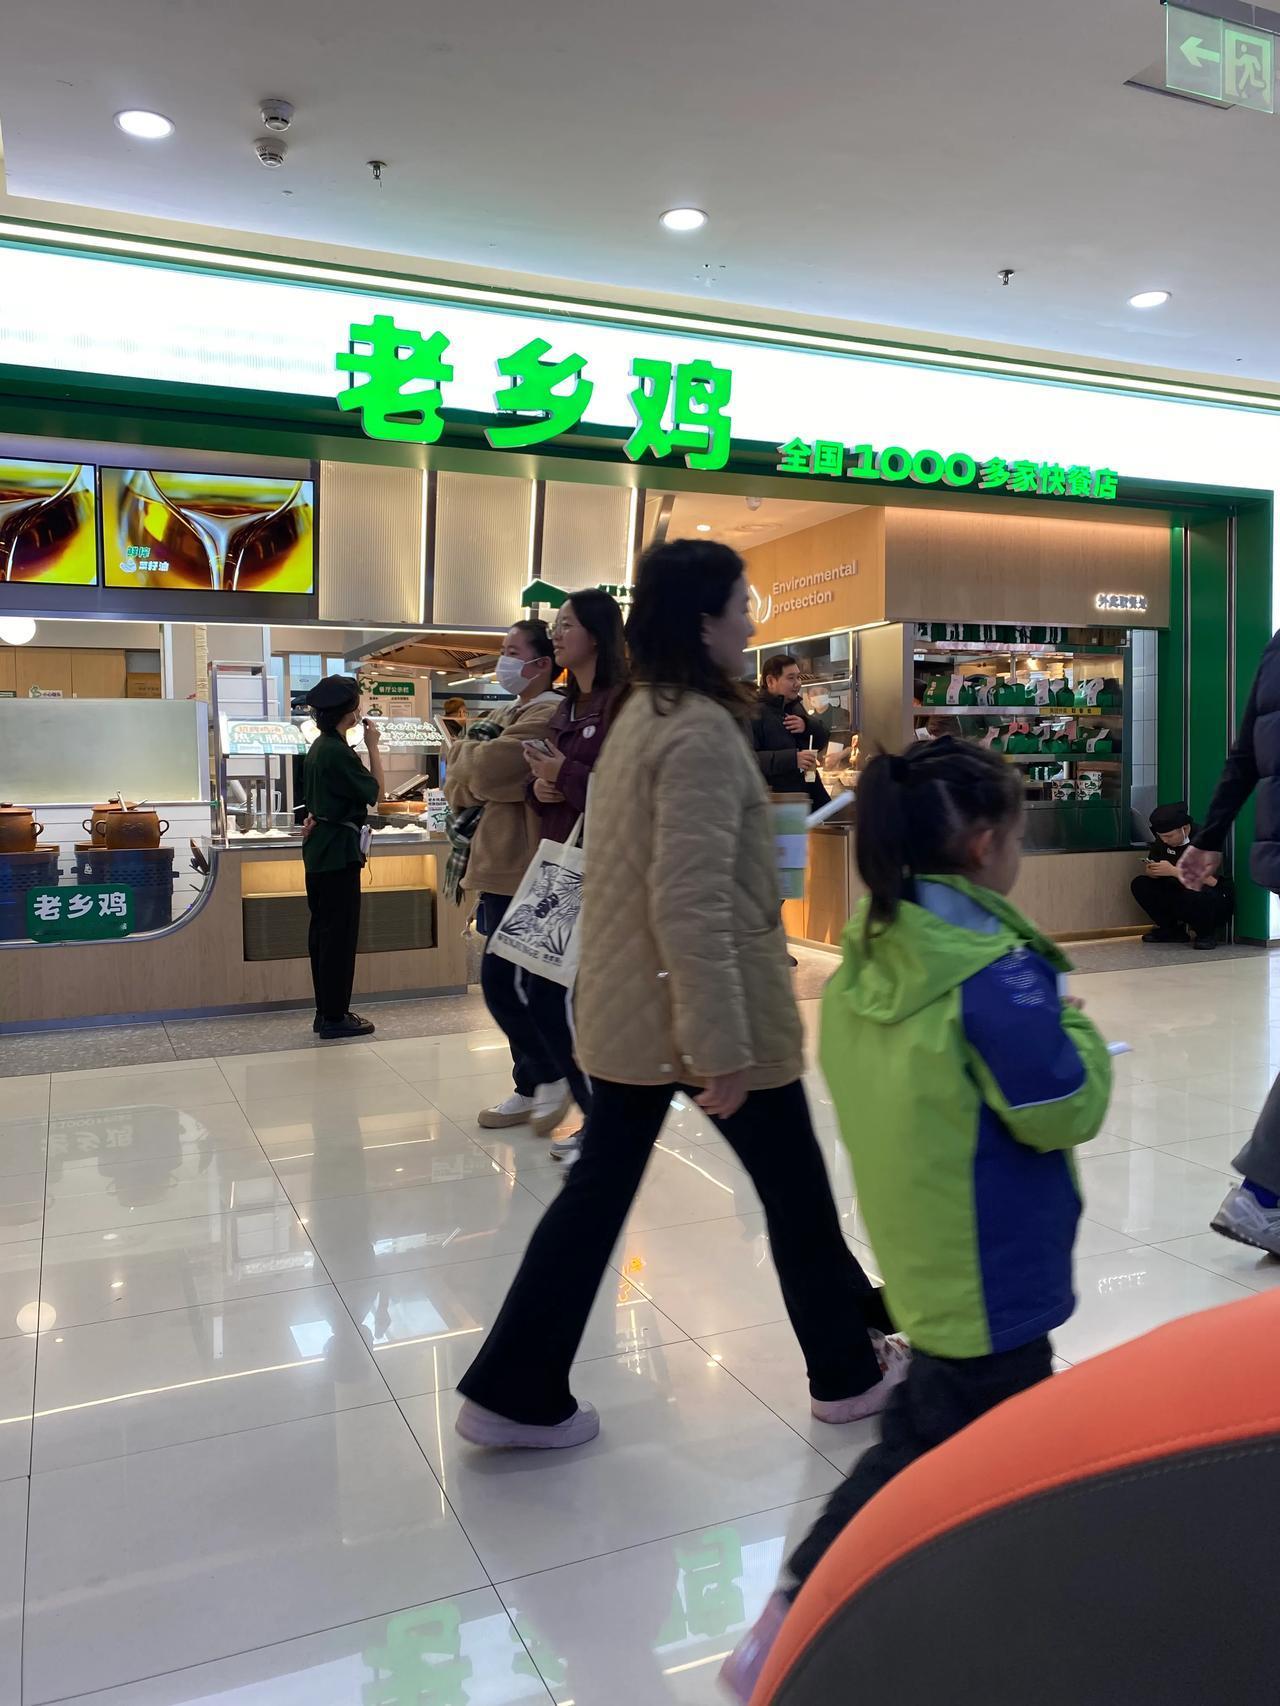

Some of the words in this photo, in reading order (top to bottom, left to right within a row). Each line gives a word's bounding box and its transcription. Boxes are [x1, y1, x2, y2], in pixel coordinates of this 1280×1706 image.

[335, 314, 732, 470] 老乡鸡
[777, 437, 1119, 499] 全国1000多家快餐店
[772, 560, 858, 594] Environmental
[773, 590, 832, 617] protection
[34, 892, 127, 920] 老乡鸡
